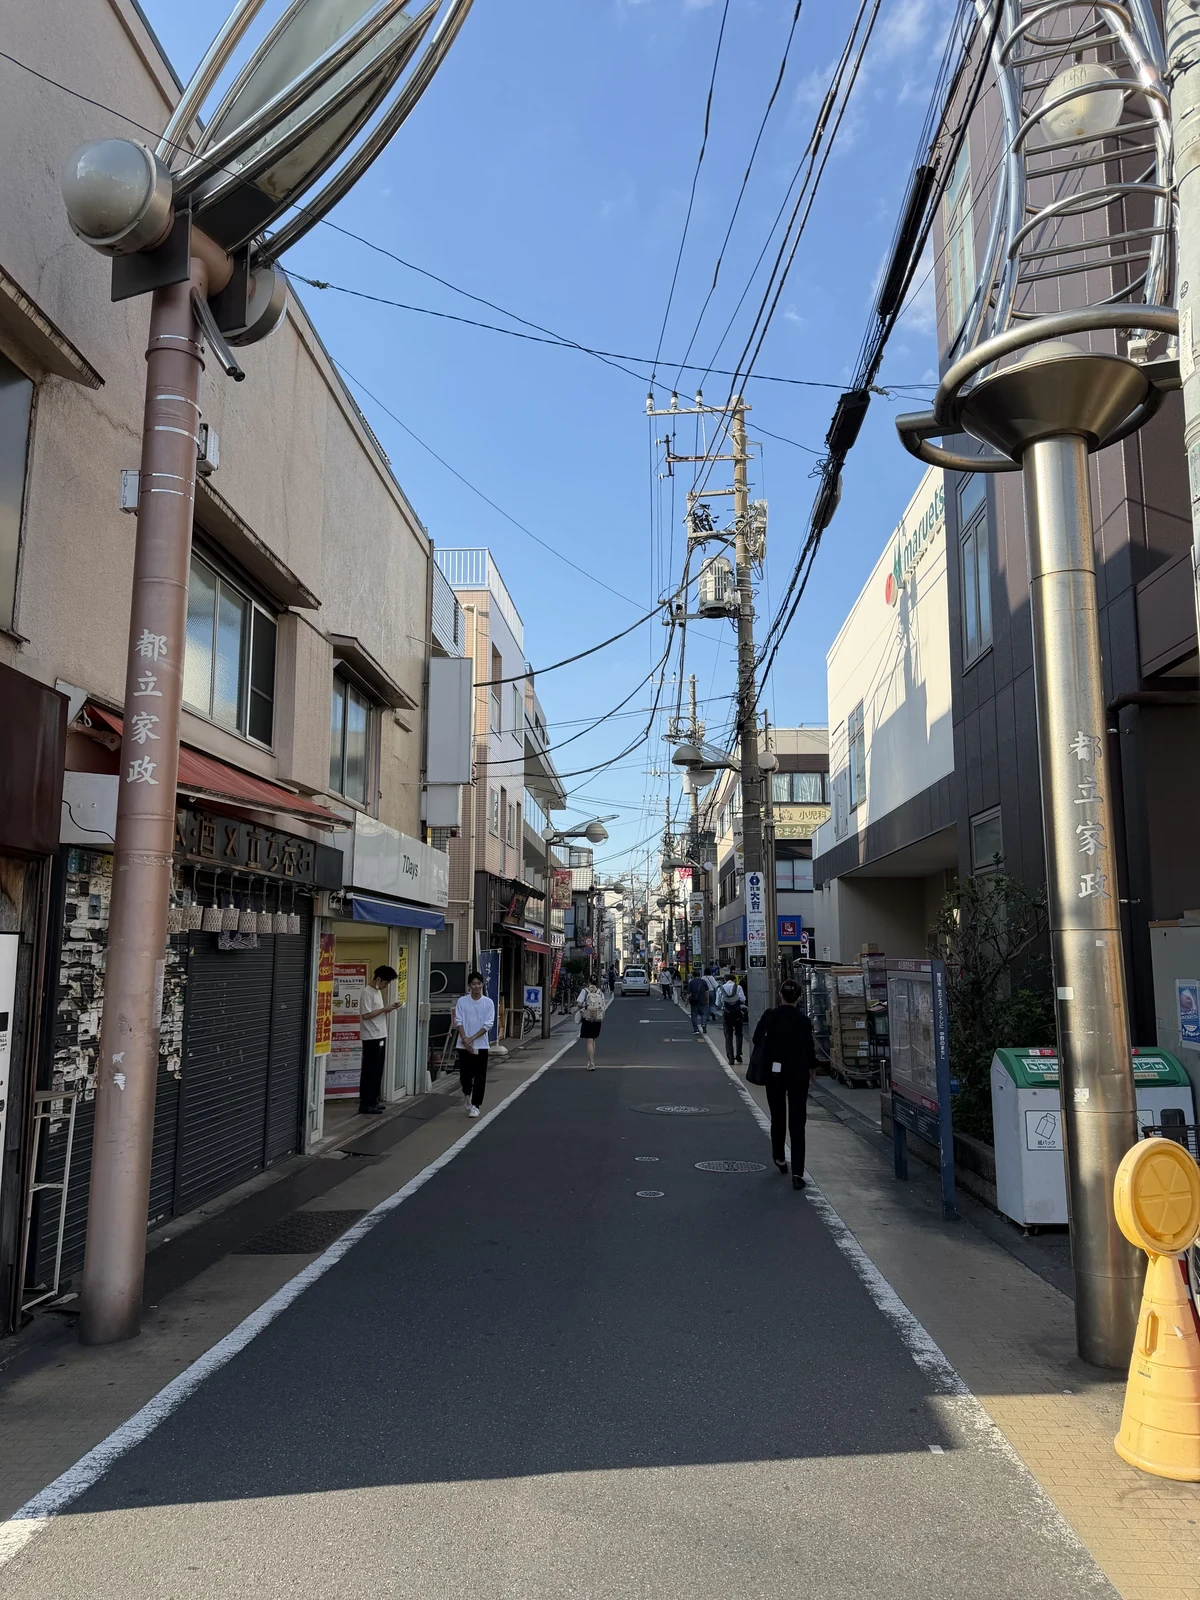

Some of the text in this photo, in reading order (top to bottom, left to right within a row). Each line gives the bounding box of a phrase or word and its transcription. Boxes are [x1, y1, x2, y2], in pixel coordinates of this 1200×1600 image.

[126, 628, 168, 785] 都立家政
[799, 810, 827, 820] 小児科
[1068, 730, 1112, 898] 都立家政
[402, 854, 419, 880] 7Days
